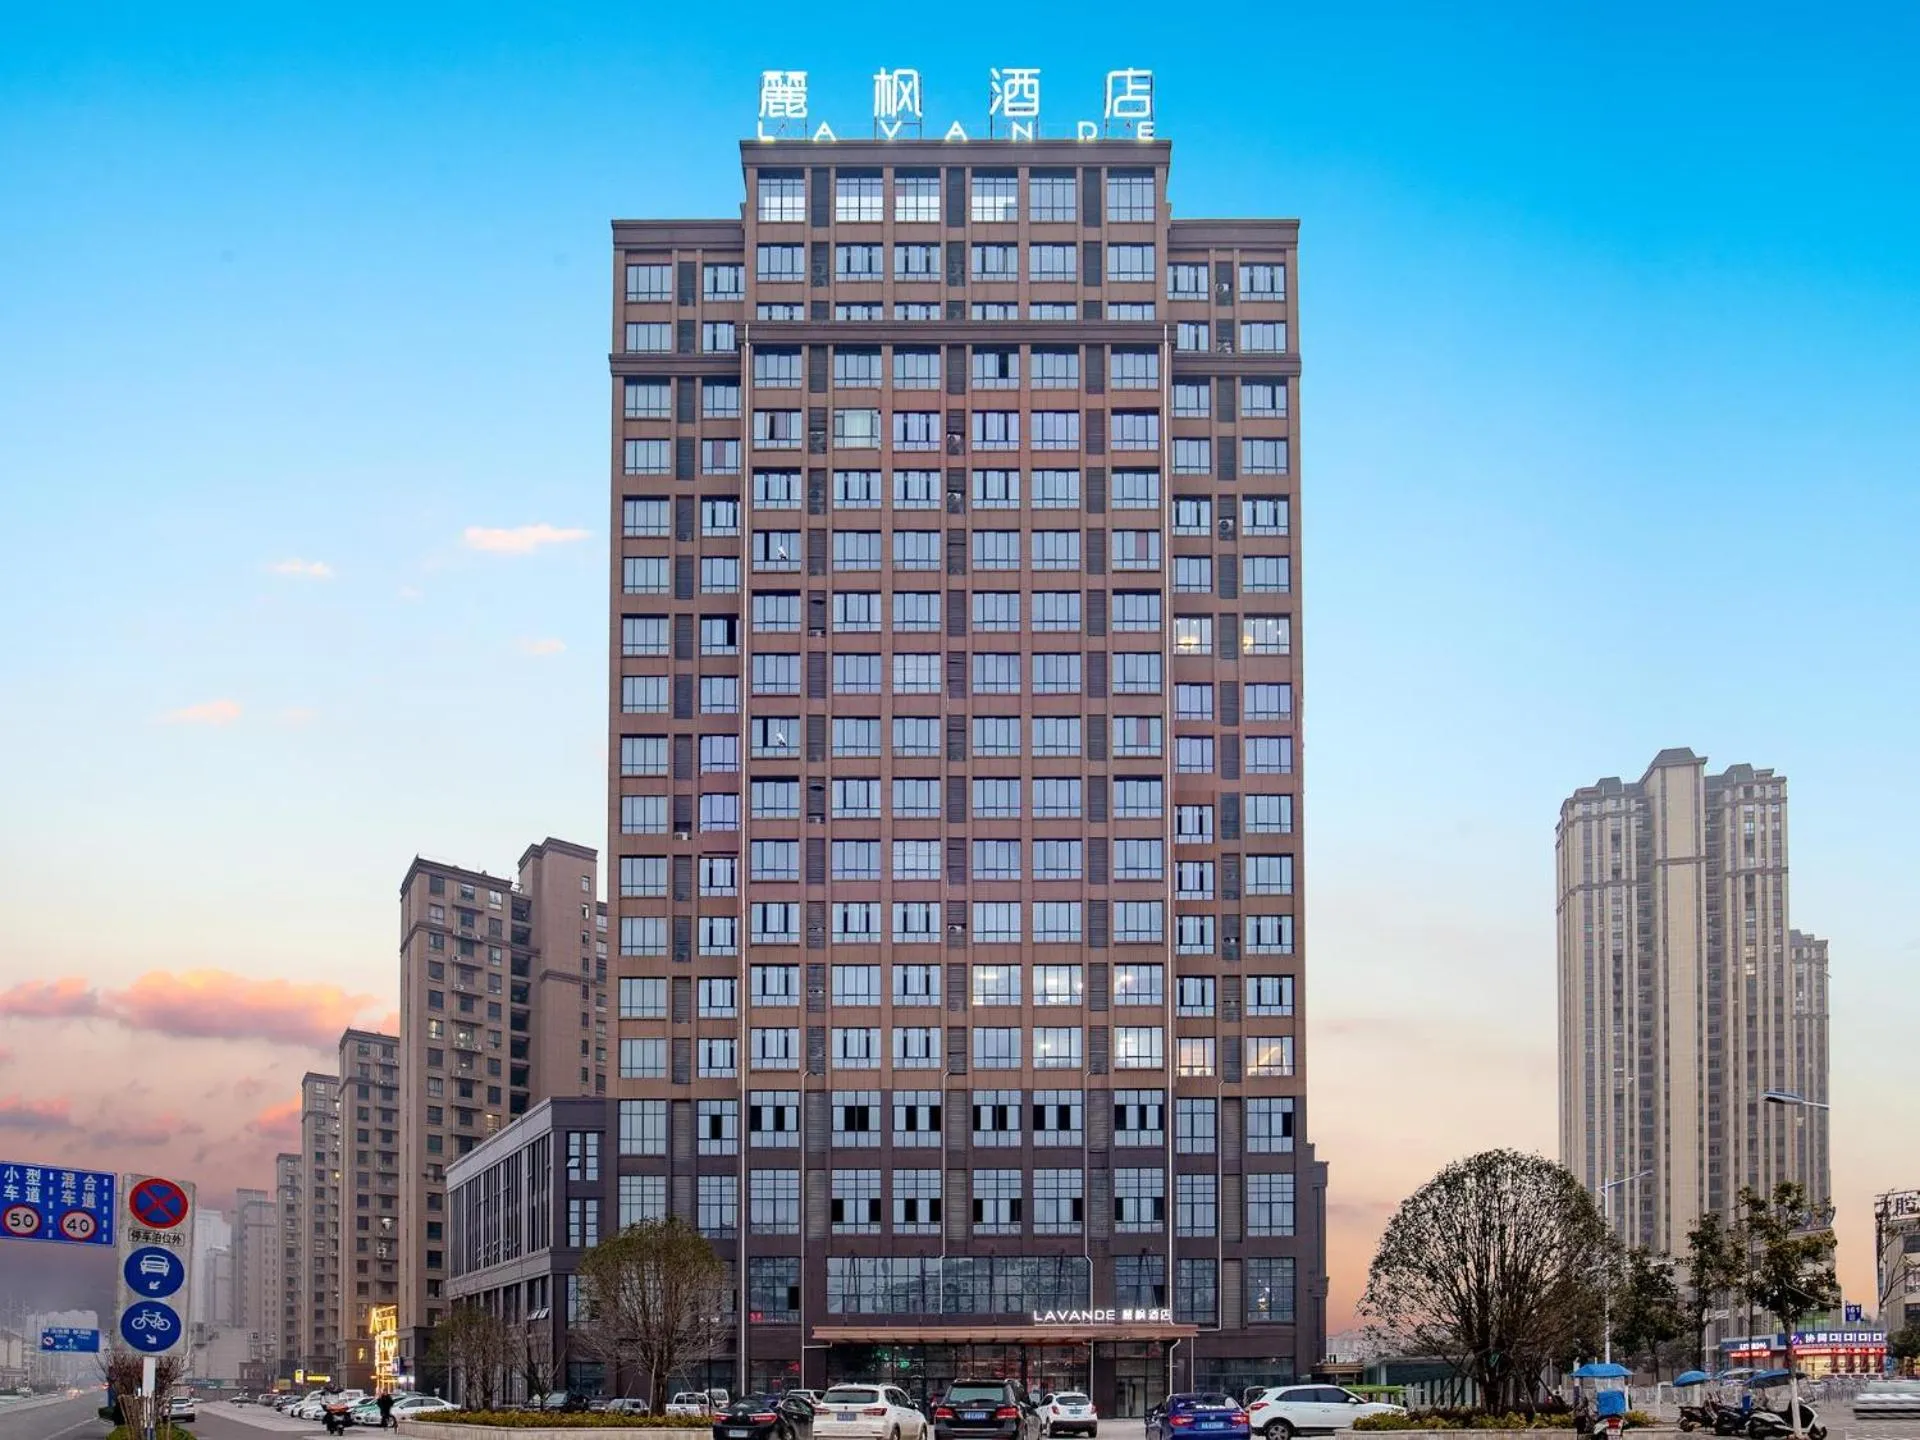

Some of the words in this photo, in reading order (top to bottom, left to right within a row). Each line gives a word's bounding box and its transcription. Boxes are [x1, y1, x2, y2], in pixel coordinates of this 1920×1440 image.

[758, 67, 1153, 117] 麗枫酒店
[757, 121, 1155, 142] LAVANDE
[4, 1166, 41, 1186] 小型
[61, 1172, 97, 1191] 混合
[3, 1184, 40, 1203] 车道
[60, 1190, 97, 1209] 车道
[10, 1212, 35, 1228] 50
[66, 1218, 90, 1233] 40
[1033, 1309, 1116, 1321] LAVANDE
